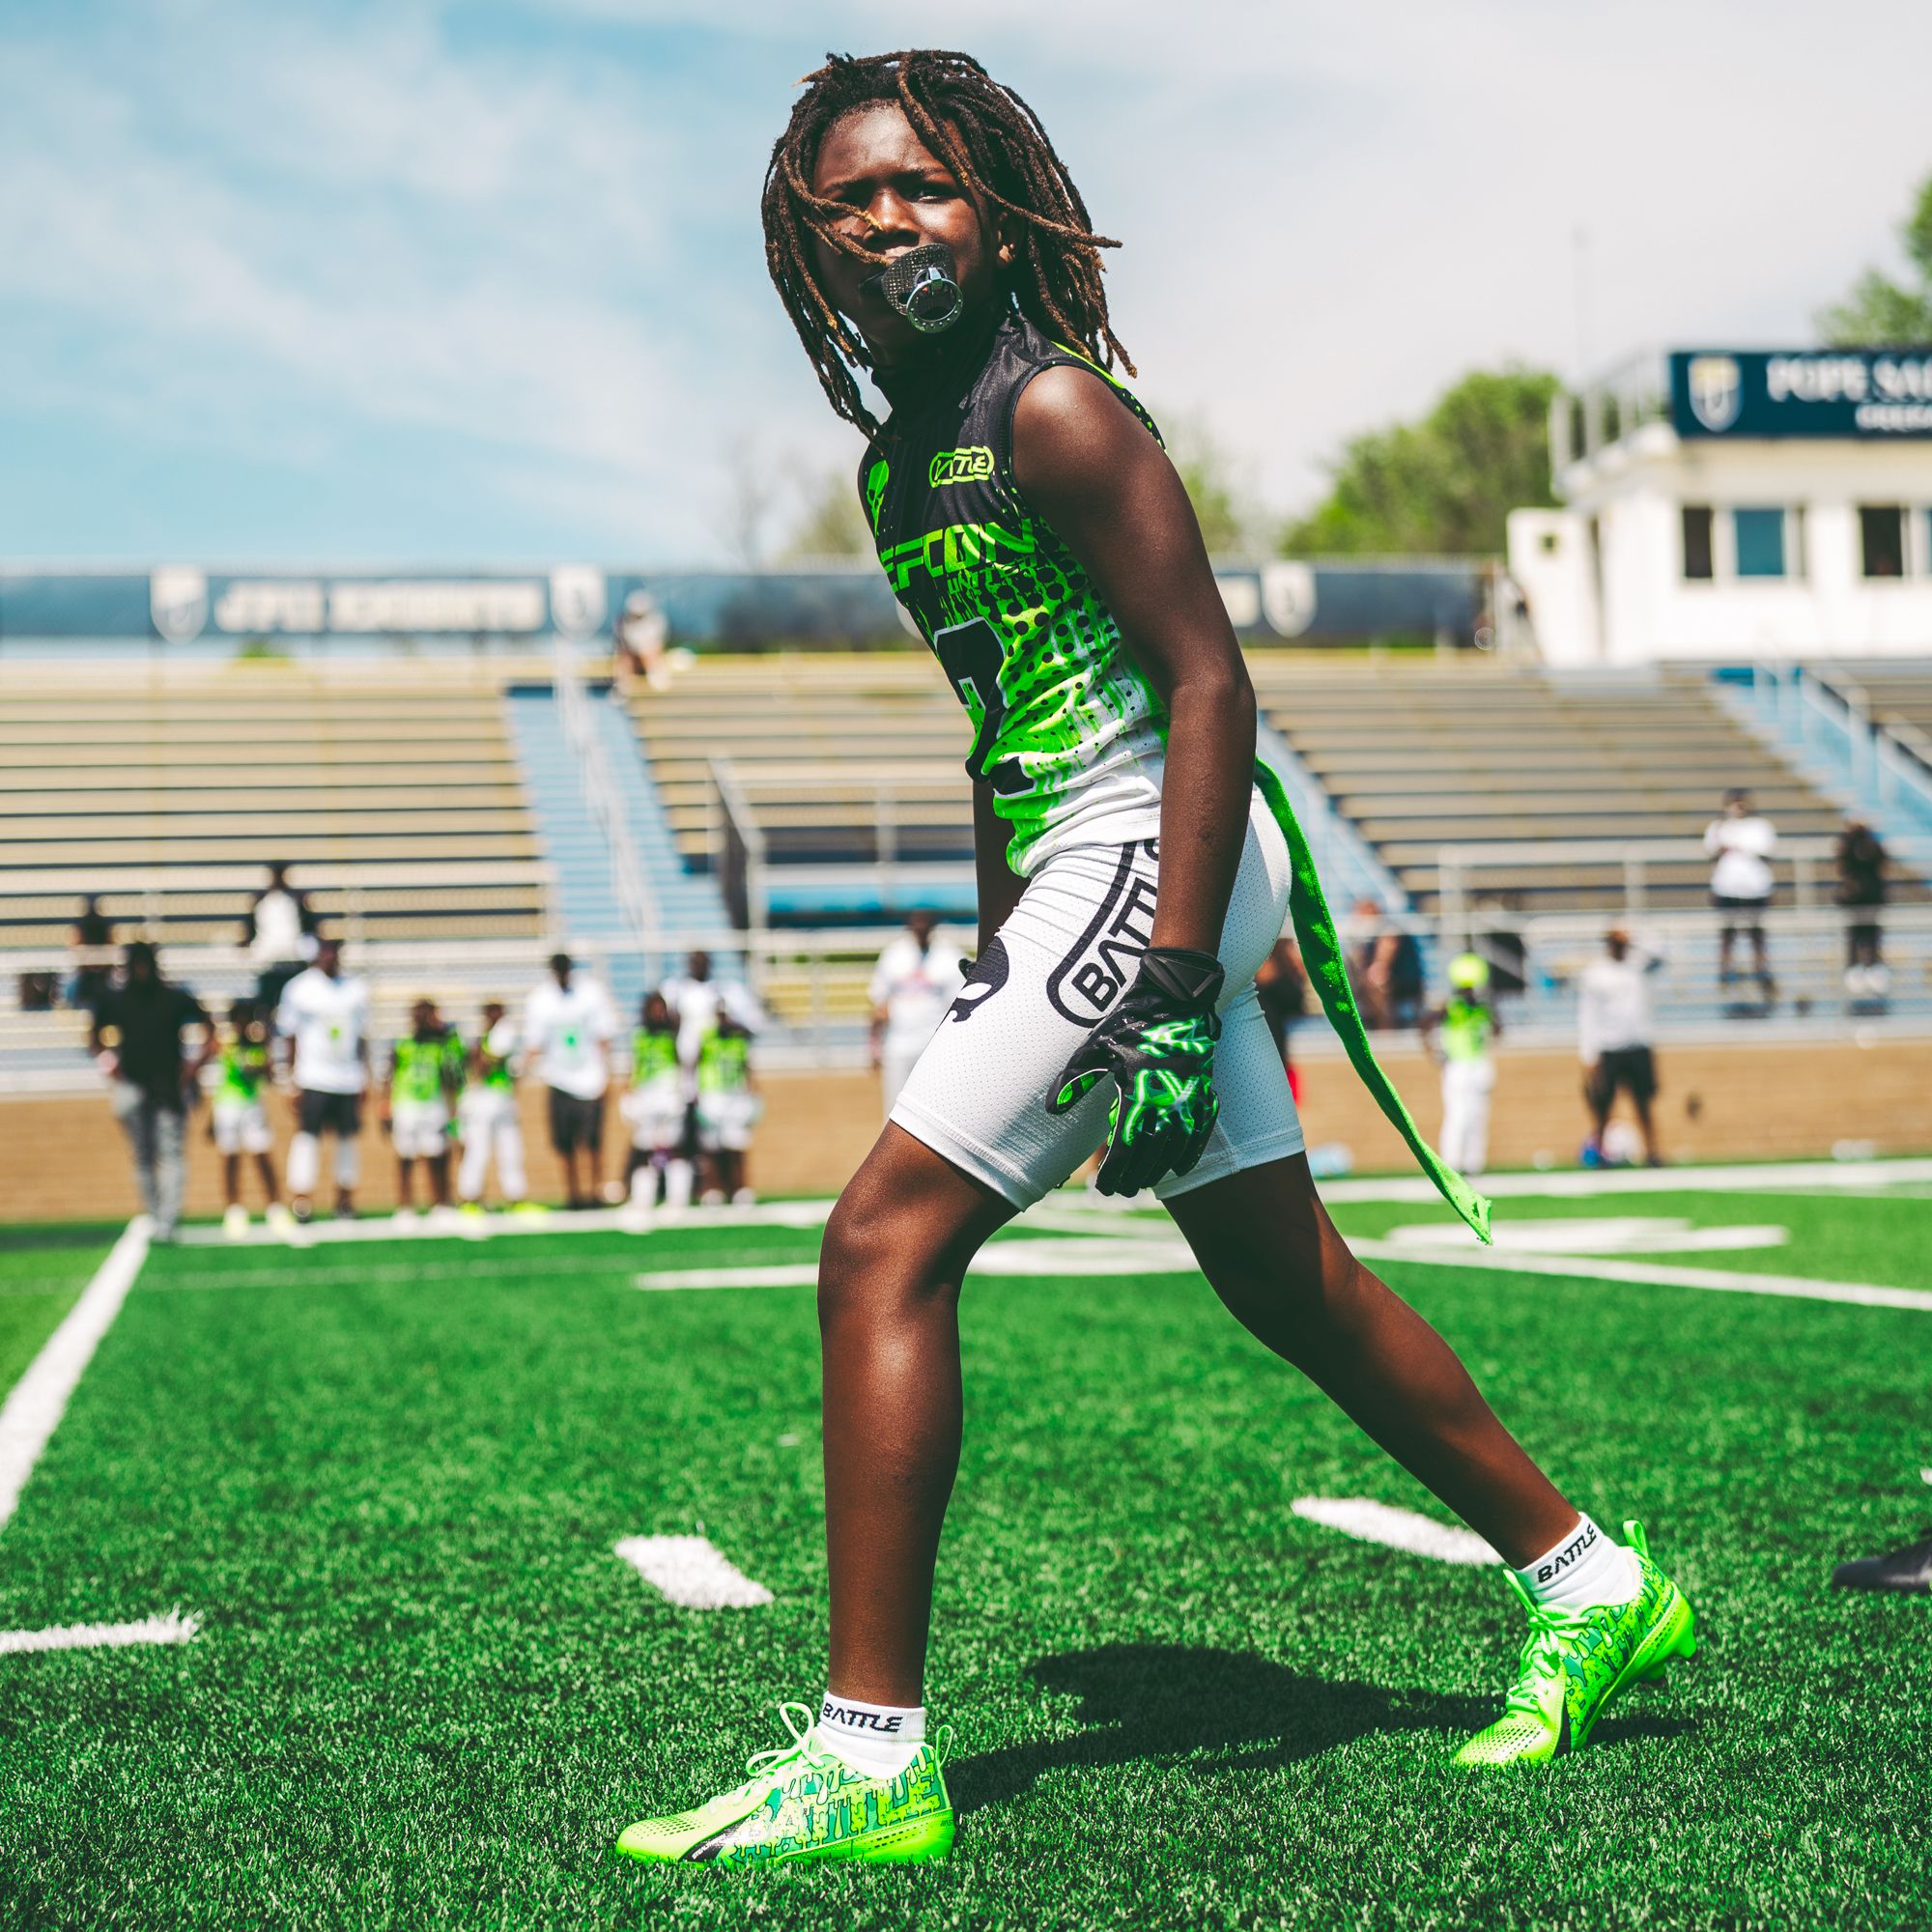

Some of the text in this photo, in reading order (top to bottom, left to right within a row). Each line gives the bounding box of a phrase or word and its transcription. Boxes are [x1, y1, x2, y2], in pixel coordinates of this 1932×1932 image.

[1070, 838, 1159, 1012] BATT
[1537, 1522, 1597, 1583] BATTLE
[822, 1702, 903, 1733] BATTLE
